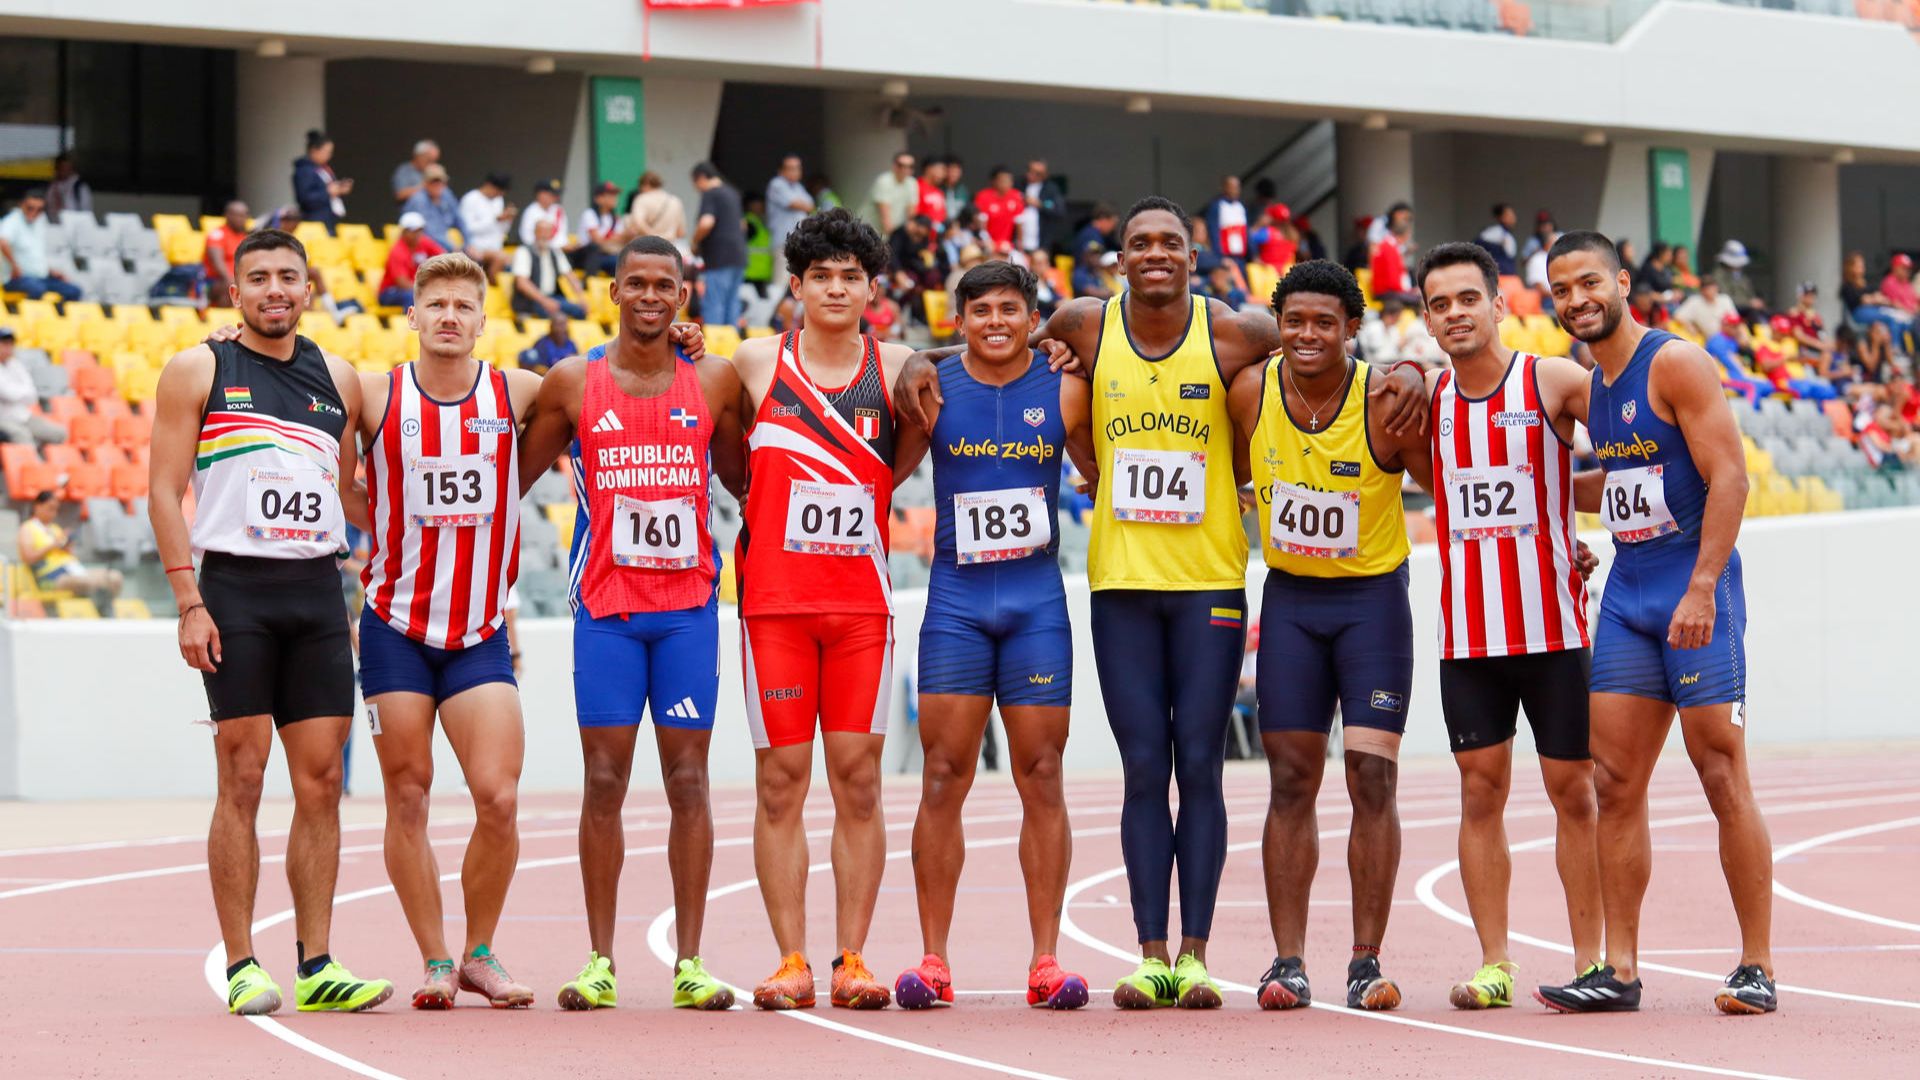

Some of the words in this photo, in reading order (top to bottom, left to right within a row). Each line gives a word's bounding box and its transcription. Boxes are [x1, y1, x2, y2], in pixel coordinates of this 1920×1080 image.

[325, 405, 342, 416] FAB
[771, 403, 801, 417] PERÚ
[1497, 419, 1539, 427] ATLETISMO
[1499, 411, 1537, 419] PARAGUAY
[472, 425, 509, 433] ATLETISMO
[1106, 411, 1211, 445] COLOMBIA
[597, 445, 695, 467] REPUBLICA
[423, 469, 482, 505] 153
[595, 467, 701, 491] DOMINICANA
[1127, 464, 1189, 501] 104
[260, 489, 322, 523] 043
[1459, 480, 1517, 518] 152
[1606, 483, 1651, 522] 184
[629, 512, 681, 548] 160
[801, 503, 864, 537] 012
[968, 503, 1032, 541] 183
[1278, 498, 1344, 539] 400
[764, 684, 803, 701] PERÚ
